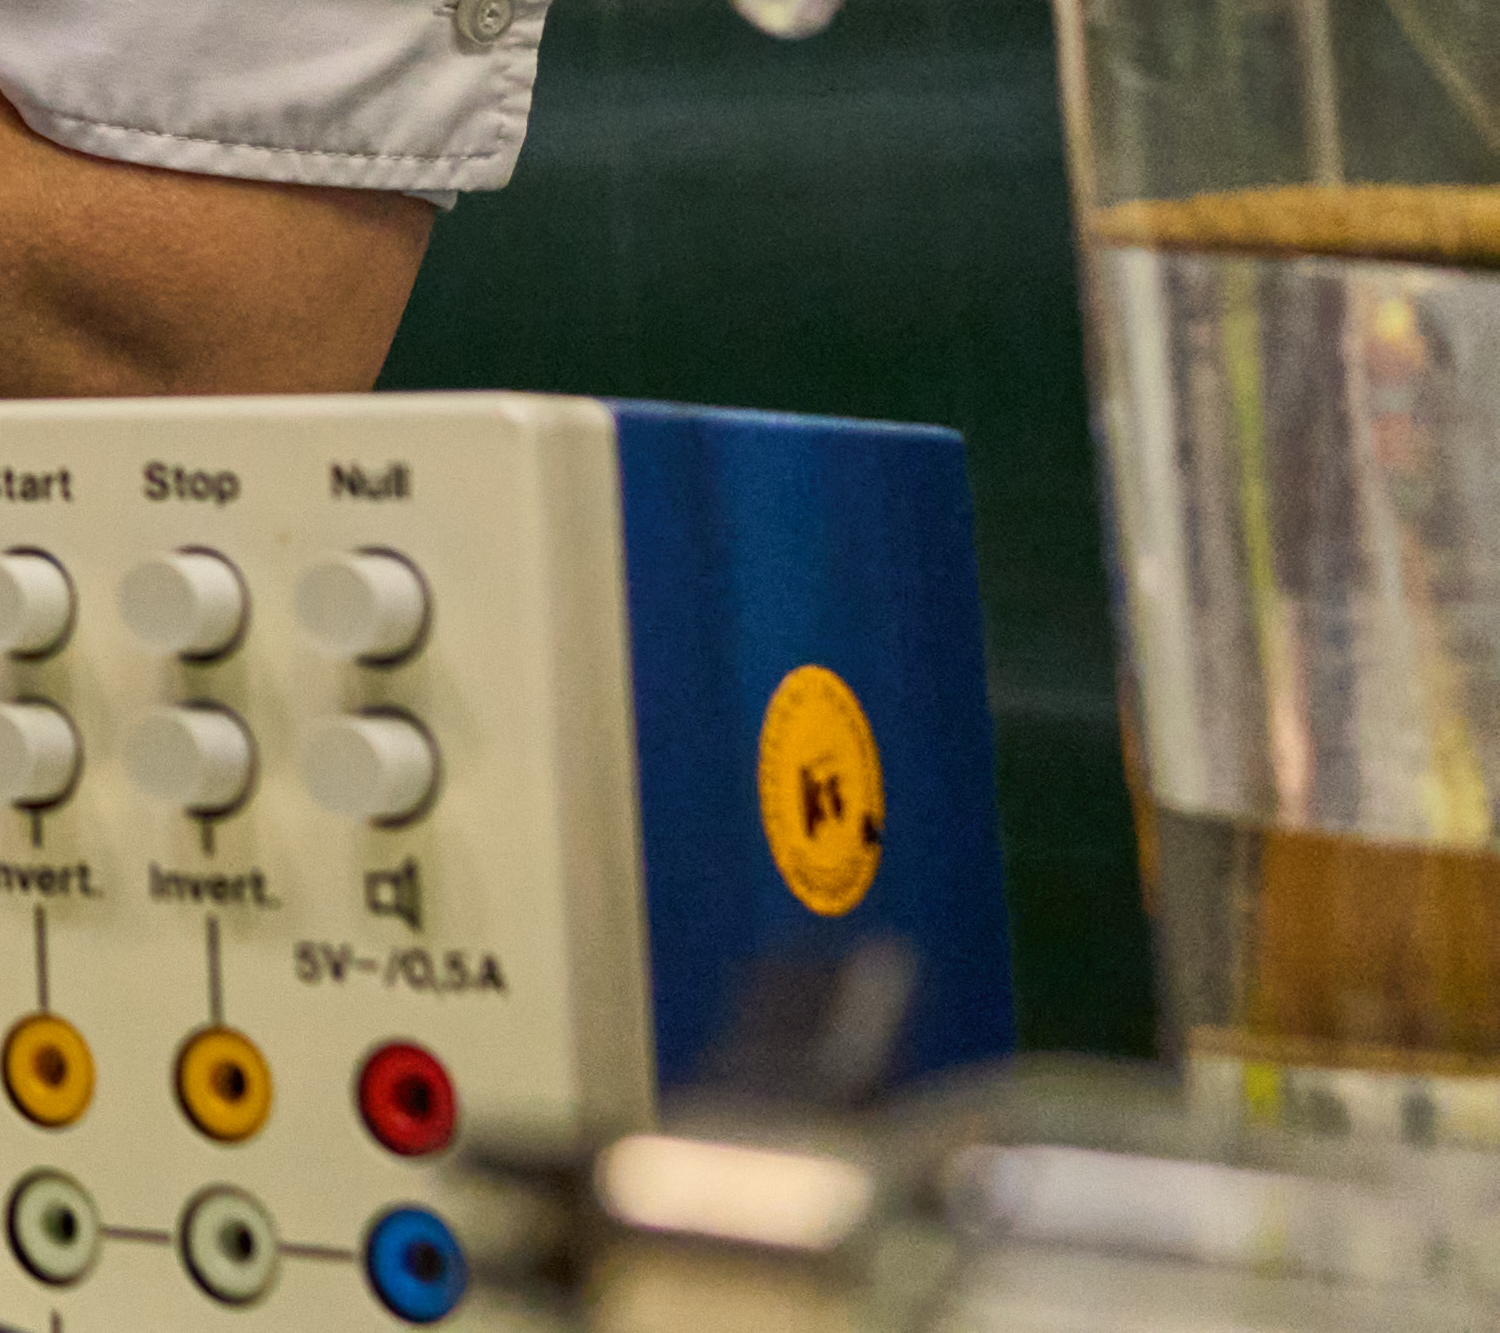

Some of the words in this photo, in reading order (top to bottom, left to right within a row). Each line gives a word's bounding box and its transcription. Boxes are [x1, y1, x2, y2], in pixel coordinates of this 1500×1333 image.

[143, 462, 240, 506] Stop
[330, 463, 412, 501] Null
[148, 863, 282, 909] Invert.
